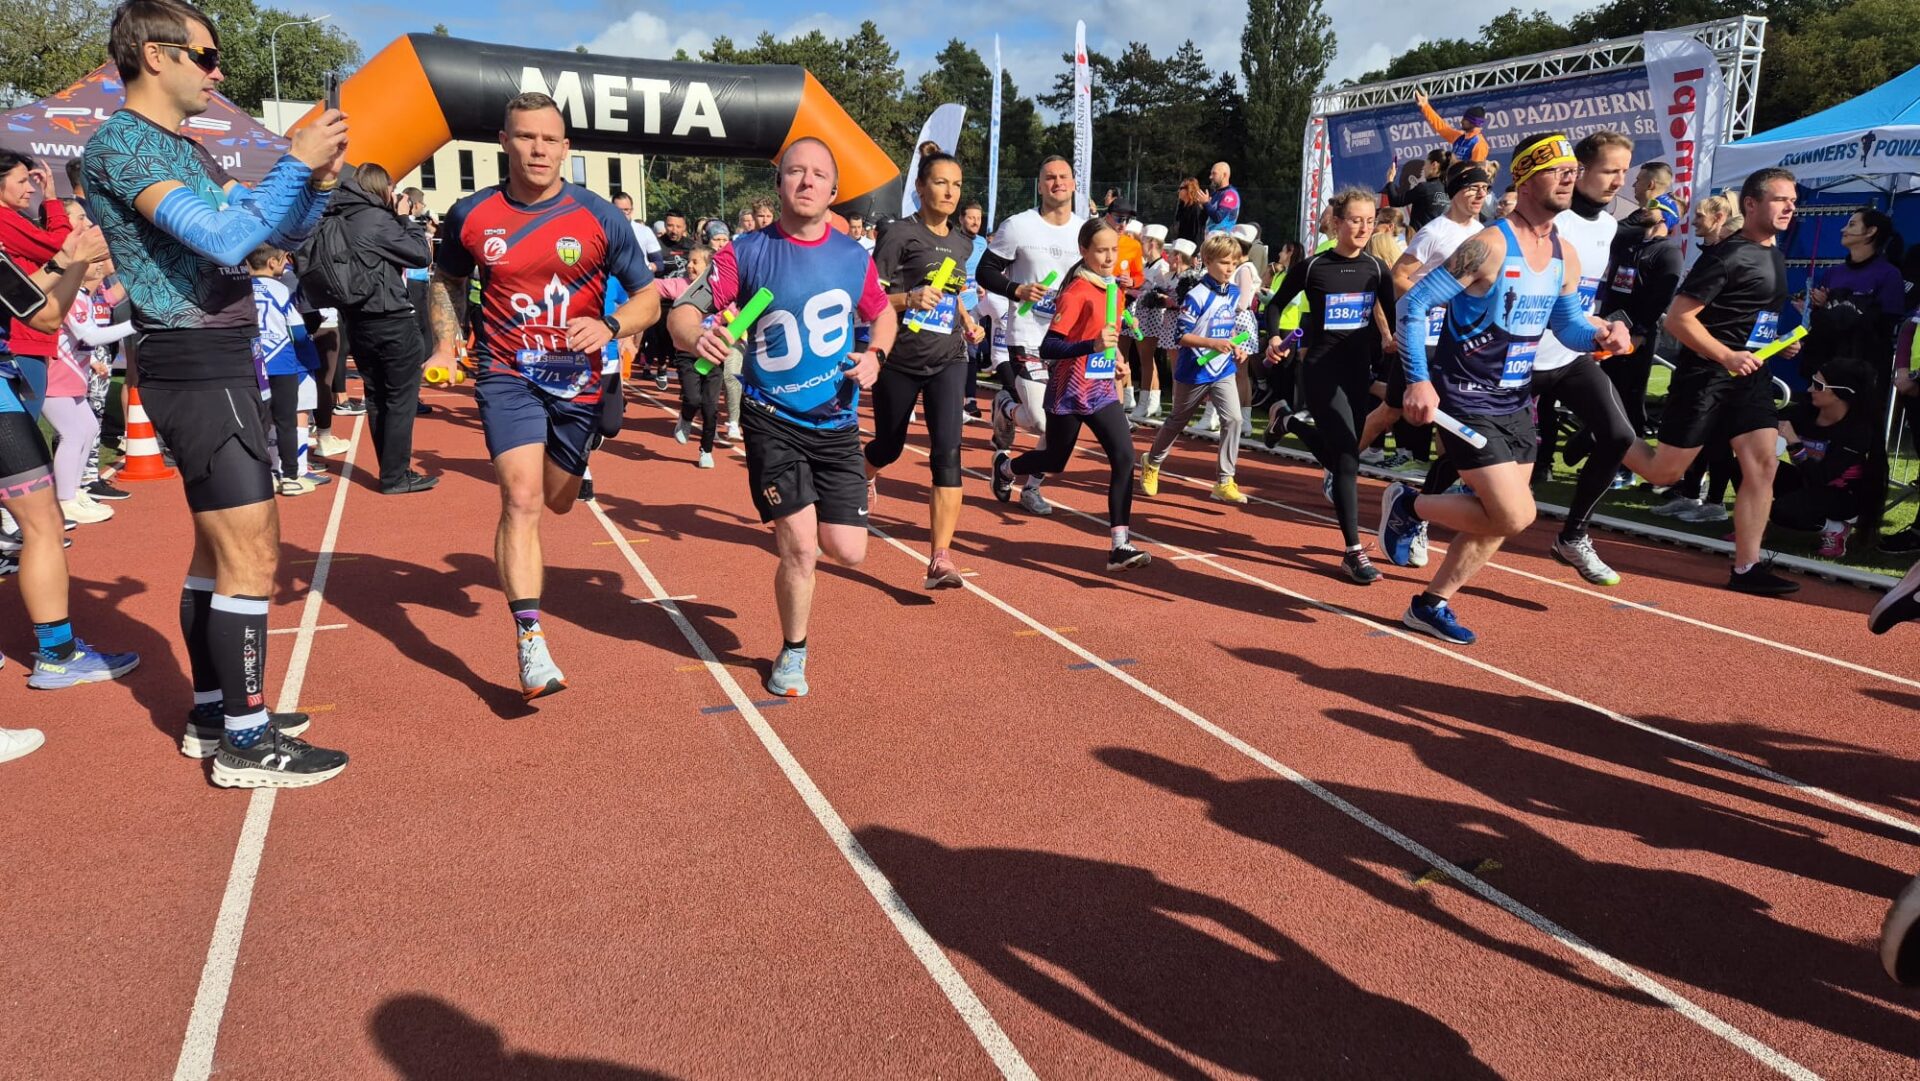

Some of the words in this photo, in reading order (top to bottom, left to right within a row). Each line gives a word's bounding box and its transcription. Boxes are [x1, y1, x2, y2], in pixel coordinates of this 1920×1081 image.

[521, 66, 727, 138] META
[1485, 110, 1509, 130] 20
[1512, 90, 1655, 126] PAŹDZIERNI
[1395, 145, 1422, 160] POD
[1634, 115, 1660, 135] ŚR
[1873, 139, 1920, 157] POWE
[1328, 308, 1359, 320] 138/1
[1511, 311, 1547, 325] POWER
[755, 288, 852, 372] 08
[1090, 354, 1113, 369] 66/1
[523, 365, 561, 383] 37/1
[763, 486, 782, 506] 15
[39, 663, 67, 674] HOKA
